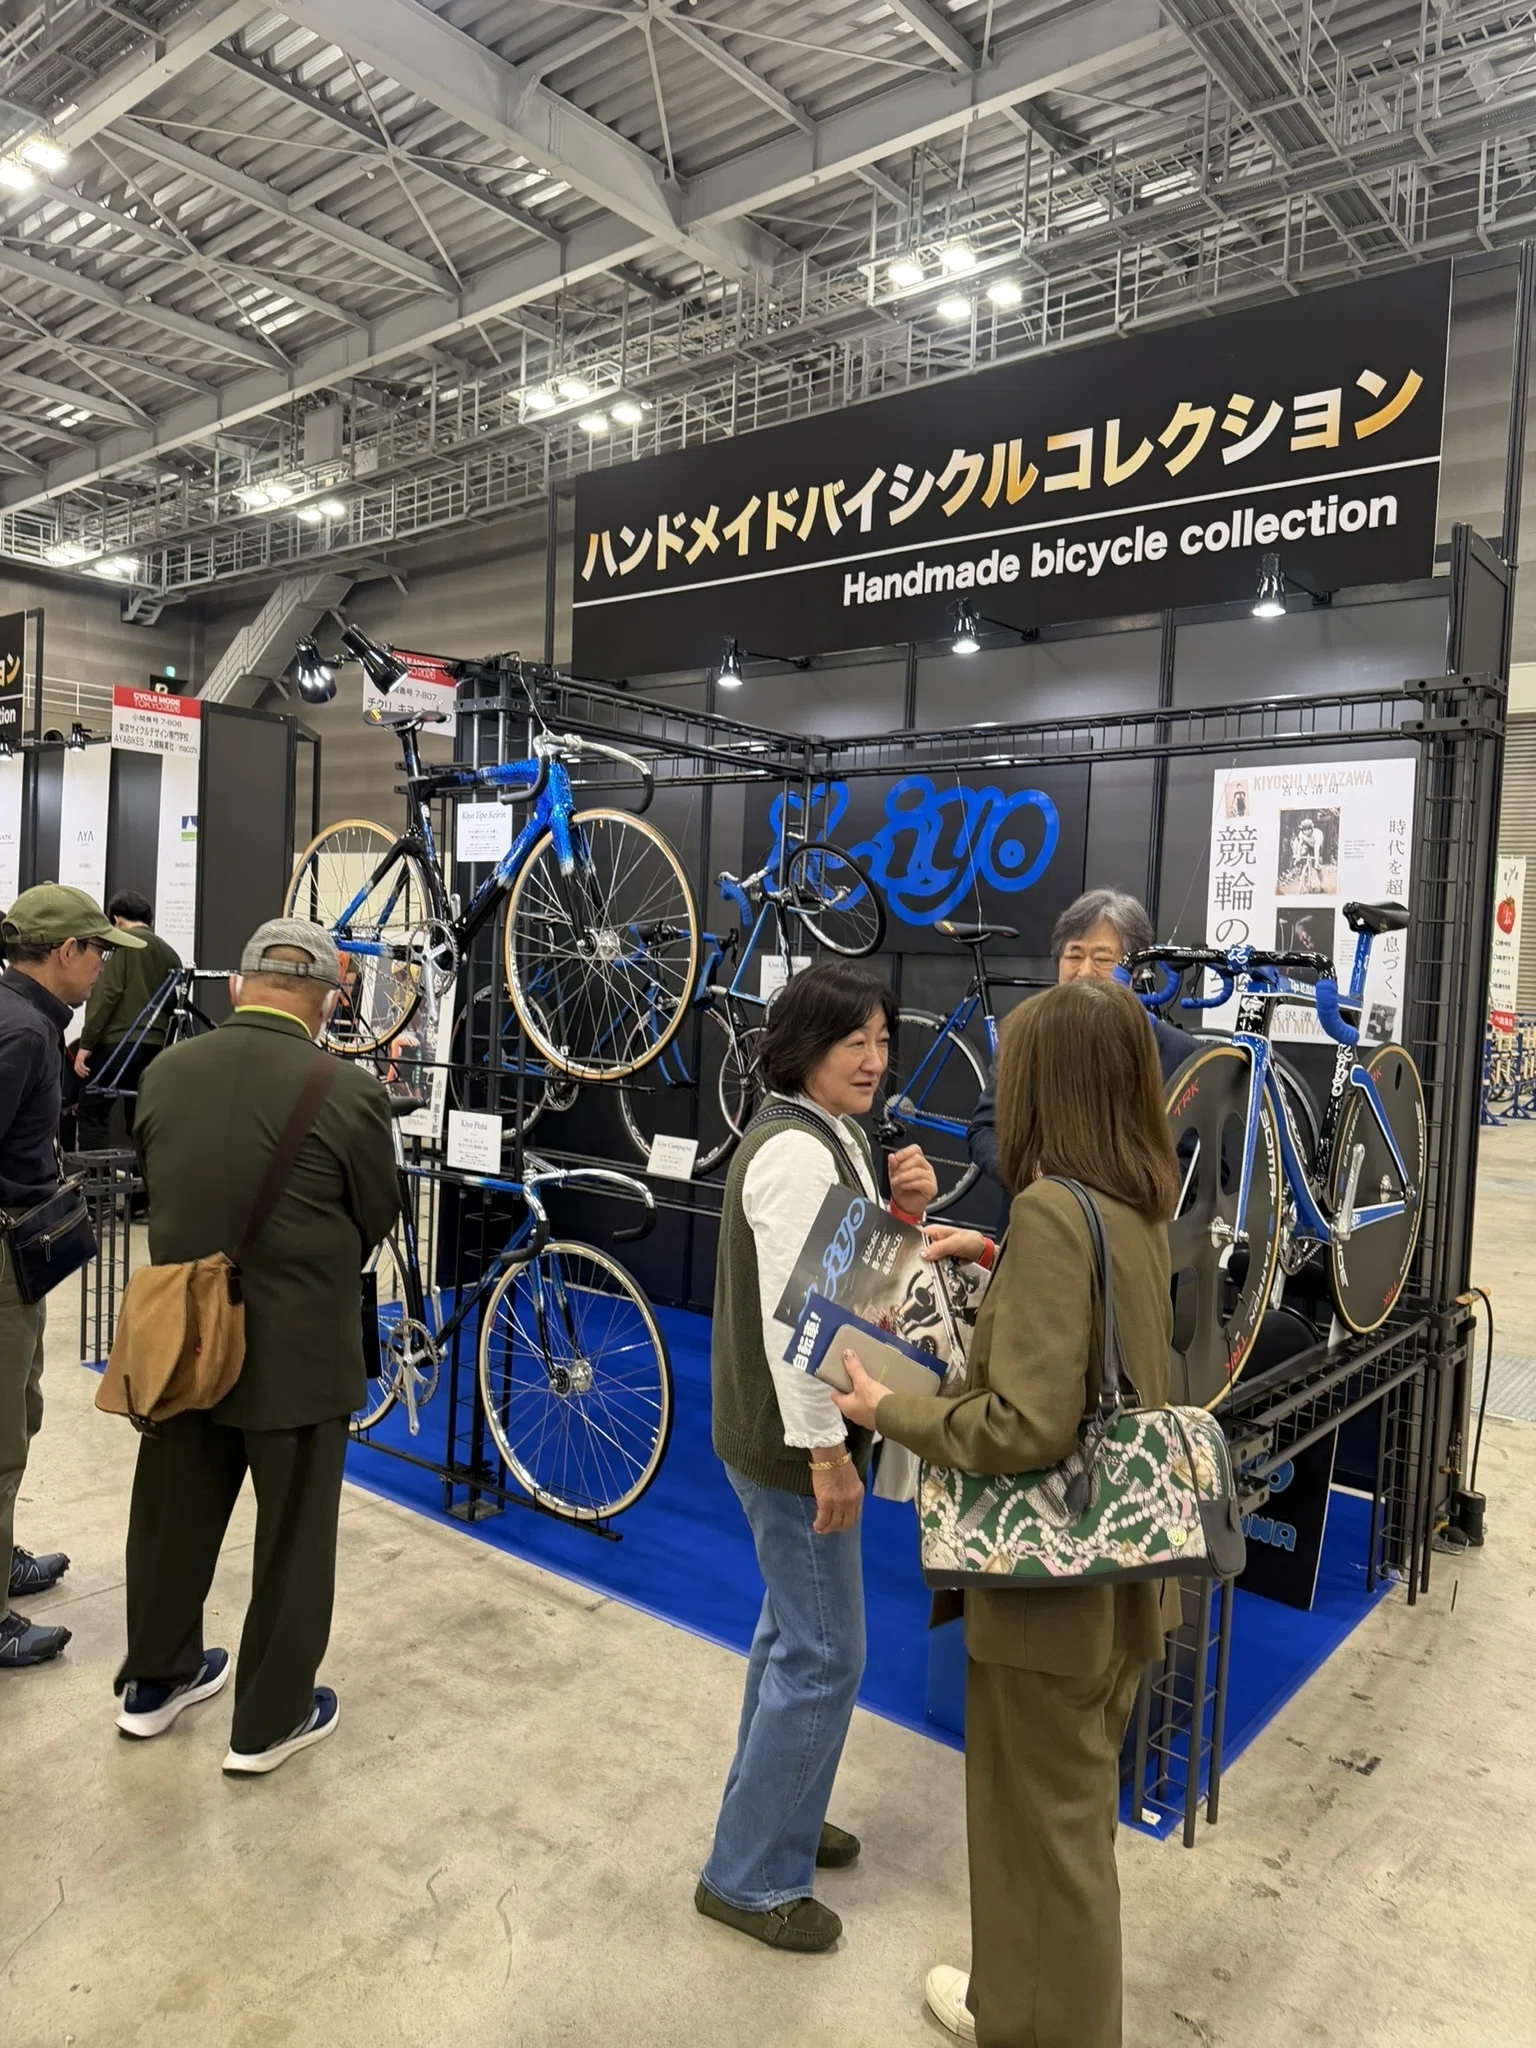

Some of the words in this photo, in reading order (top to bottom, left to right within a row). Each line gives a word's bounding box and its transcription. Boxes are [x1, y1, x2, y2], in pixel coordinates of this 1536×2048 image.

[581, 367, 1424, 583] ハンドメイドバイシクルコレクション
[841, 549, 1021, 608] Handmade
[1030, 523, 1168, 578] bicycle
[1179, 494, 1399, 557] collection
[0, 653, 21, 687] ン
[133, 692, 158, 703] CYCLE
[159, 695, 181, 707] MODE
[416, 690, 437, 701] 7-807
[0, 705, 16, 725] ion
[114, 734, 144, 747] AYABIKES
[1254, 773, 1302, 791] KIYOSHI
[1307, 769, 1373, 788] MIYAZAWA
[77, 830, 94, 843] AYA
[1173, 1079, 1200, 1117] TRK
